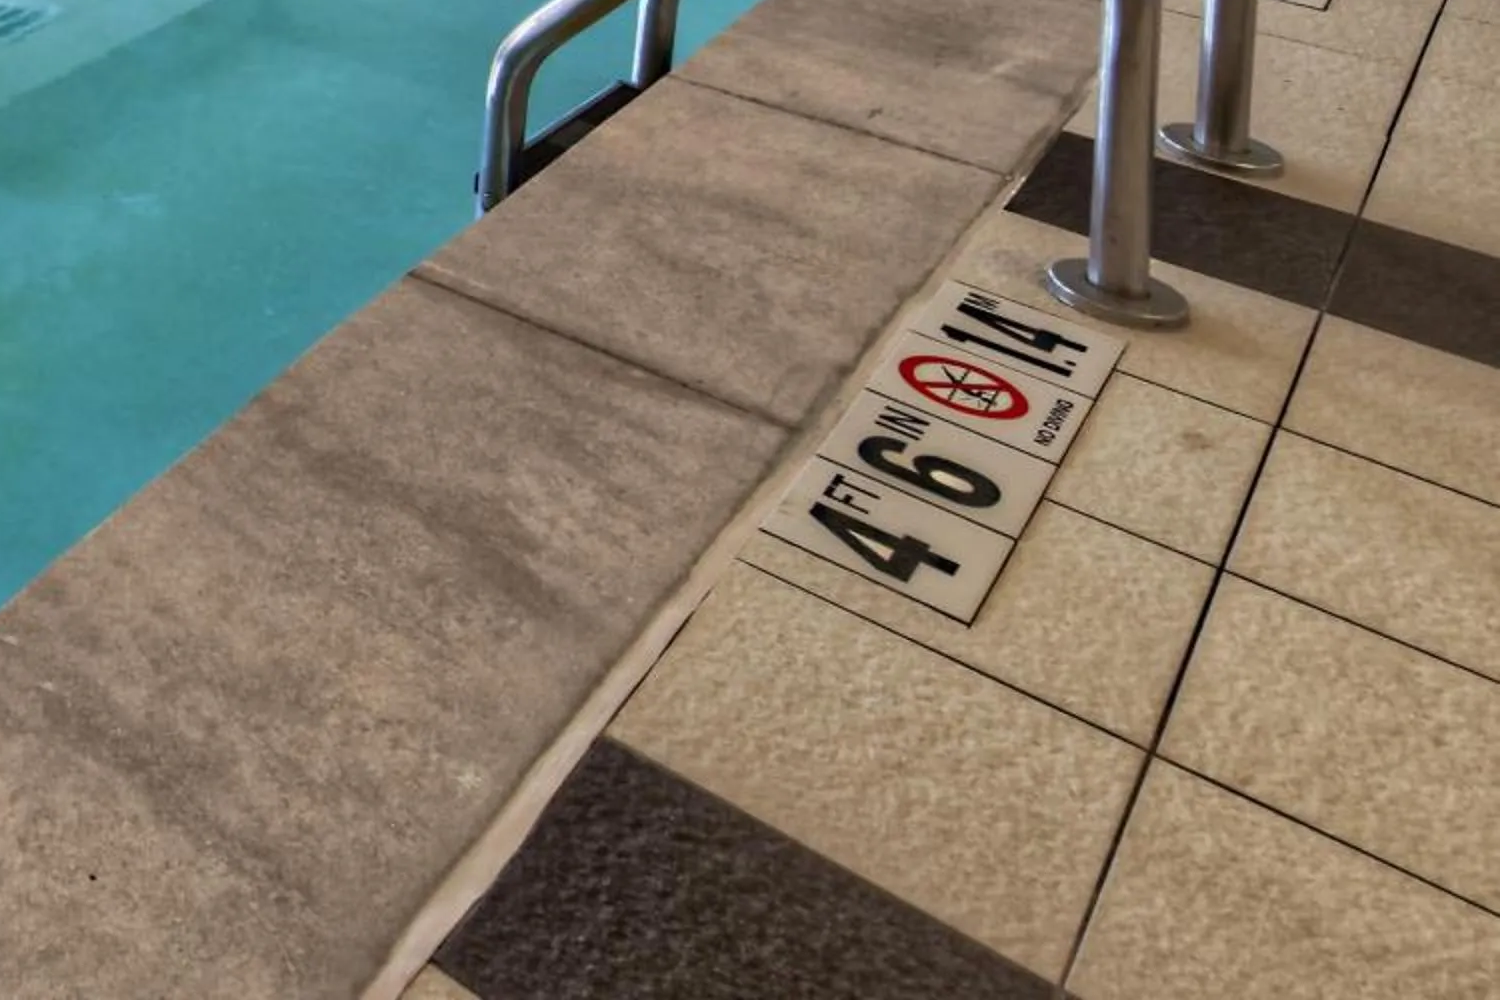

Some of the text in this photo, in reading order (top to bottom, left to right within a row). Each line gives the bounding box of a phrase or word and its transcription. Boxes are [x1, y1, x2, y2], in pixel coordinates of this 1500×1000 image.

[874, 405, 931, 441] IN
[1033, 398, 1074, 447] NO DIVING
[823, 473, 881, 515] FT
[857, 435, 1001, 508] 6
[809, 501, 960, 583] 4
